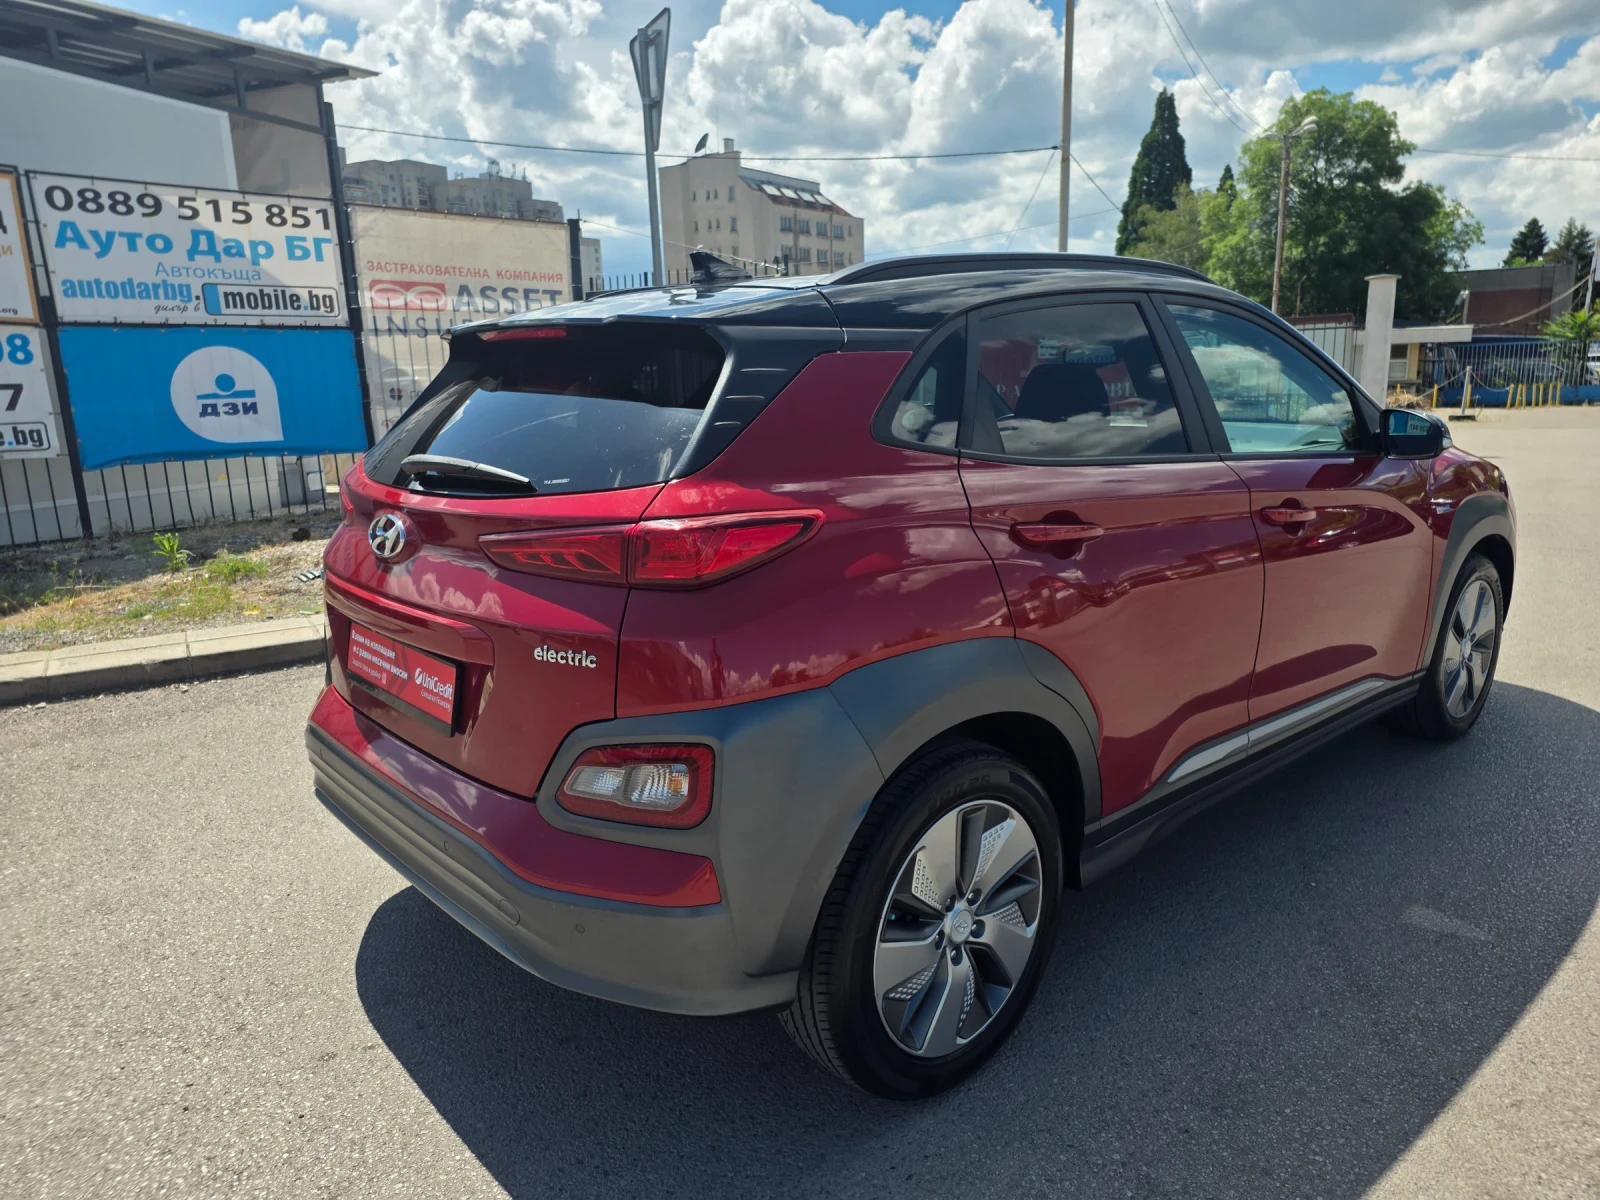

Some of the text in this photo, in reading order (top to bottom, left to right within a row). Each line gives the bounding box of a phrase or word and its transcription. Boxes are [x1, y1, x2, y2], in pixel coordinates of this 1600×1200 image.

[44, 185, 332, 231] 0889 515 851
[55, 220, 333, 266] Ауто Дар БГ
[155, 262, 262, 282] Автокъща
[366, 260, 563, 283] ЗАСТРАХОВАТЕЛНА КОМПАНИЯ
[223, 288, 335, 314] mobile.bg
[452, 284, 563, 315] ASSET
[0, 332, 35, 365] 8
[199, 401, 259, 418] ДЗИ
[533, 645, 598, 668] electric
[422, 672, 453, 700] UniCredit
